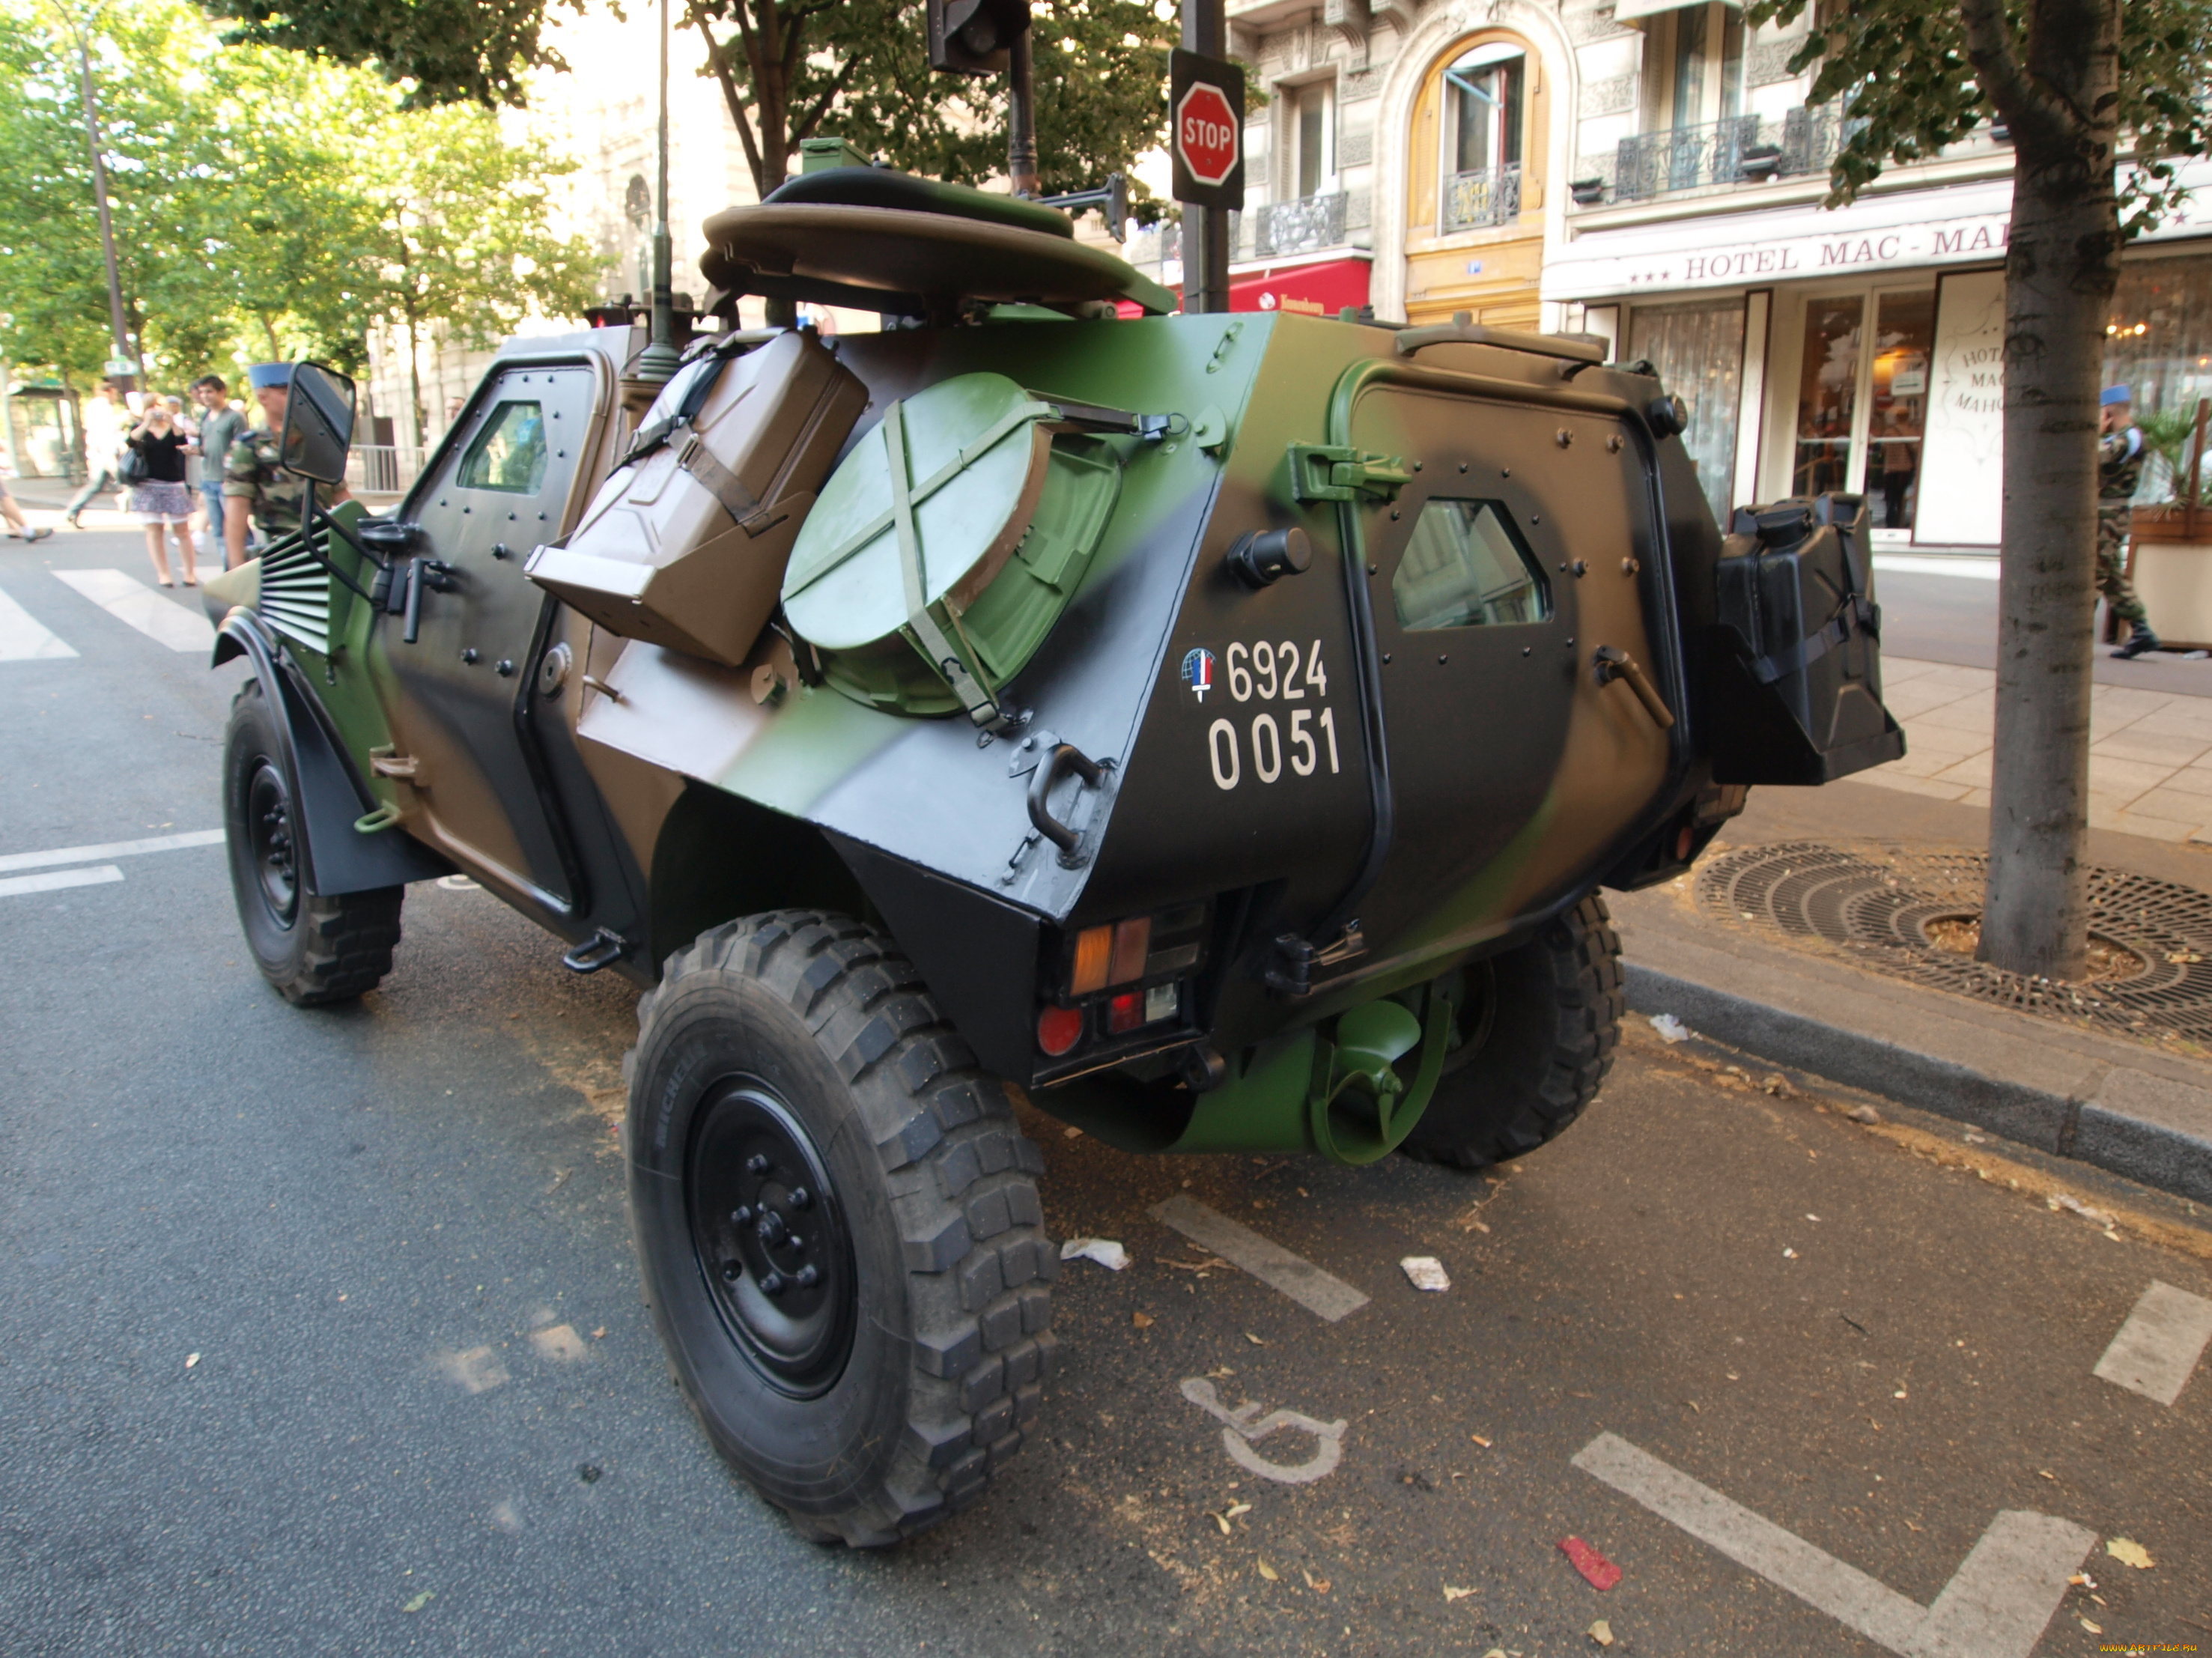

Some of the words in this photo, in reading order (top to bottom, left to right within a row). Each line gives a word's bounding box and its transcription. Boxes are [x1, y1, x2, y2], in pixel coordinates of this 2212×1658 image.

[1185, 117, 1231, 151] STOP
[1685, 247, 1799, 280] HOTEL
[1818, 234, 1901, 266] MAC
[1227, 640, 1327, 702] 6924
[1209, 707, 1339, 790] 0051
